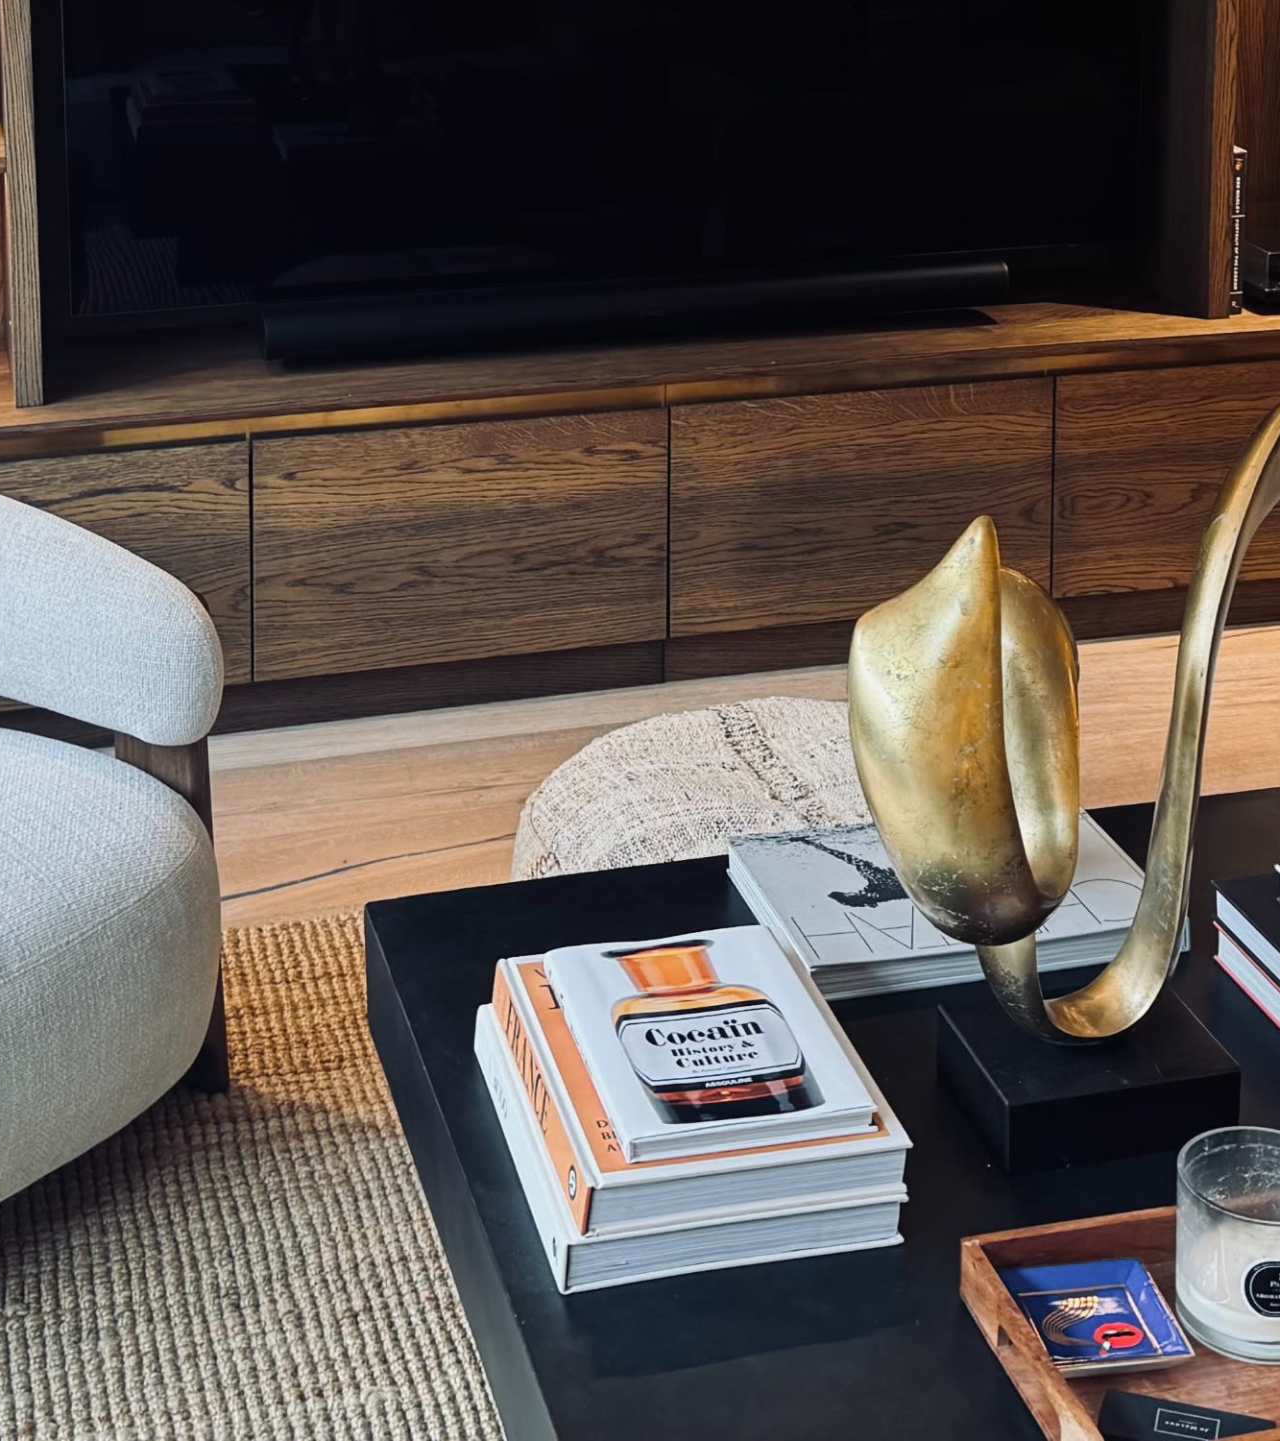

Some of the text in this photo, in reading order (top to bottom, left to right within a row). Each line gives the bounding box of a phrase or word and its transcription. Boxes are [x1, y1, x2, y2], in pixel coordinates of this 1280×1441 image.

[645, 1019, 763, 1047] Cocaïn
[671, 1040, 754, 1057] History &
[676, 1051, 759, 1068] Culture
[504, 992, 549, 1135] FRANCE
